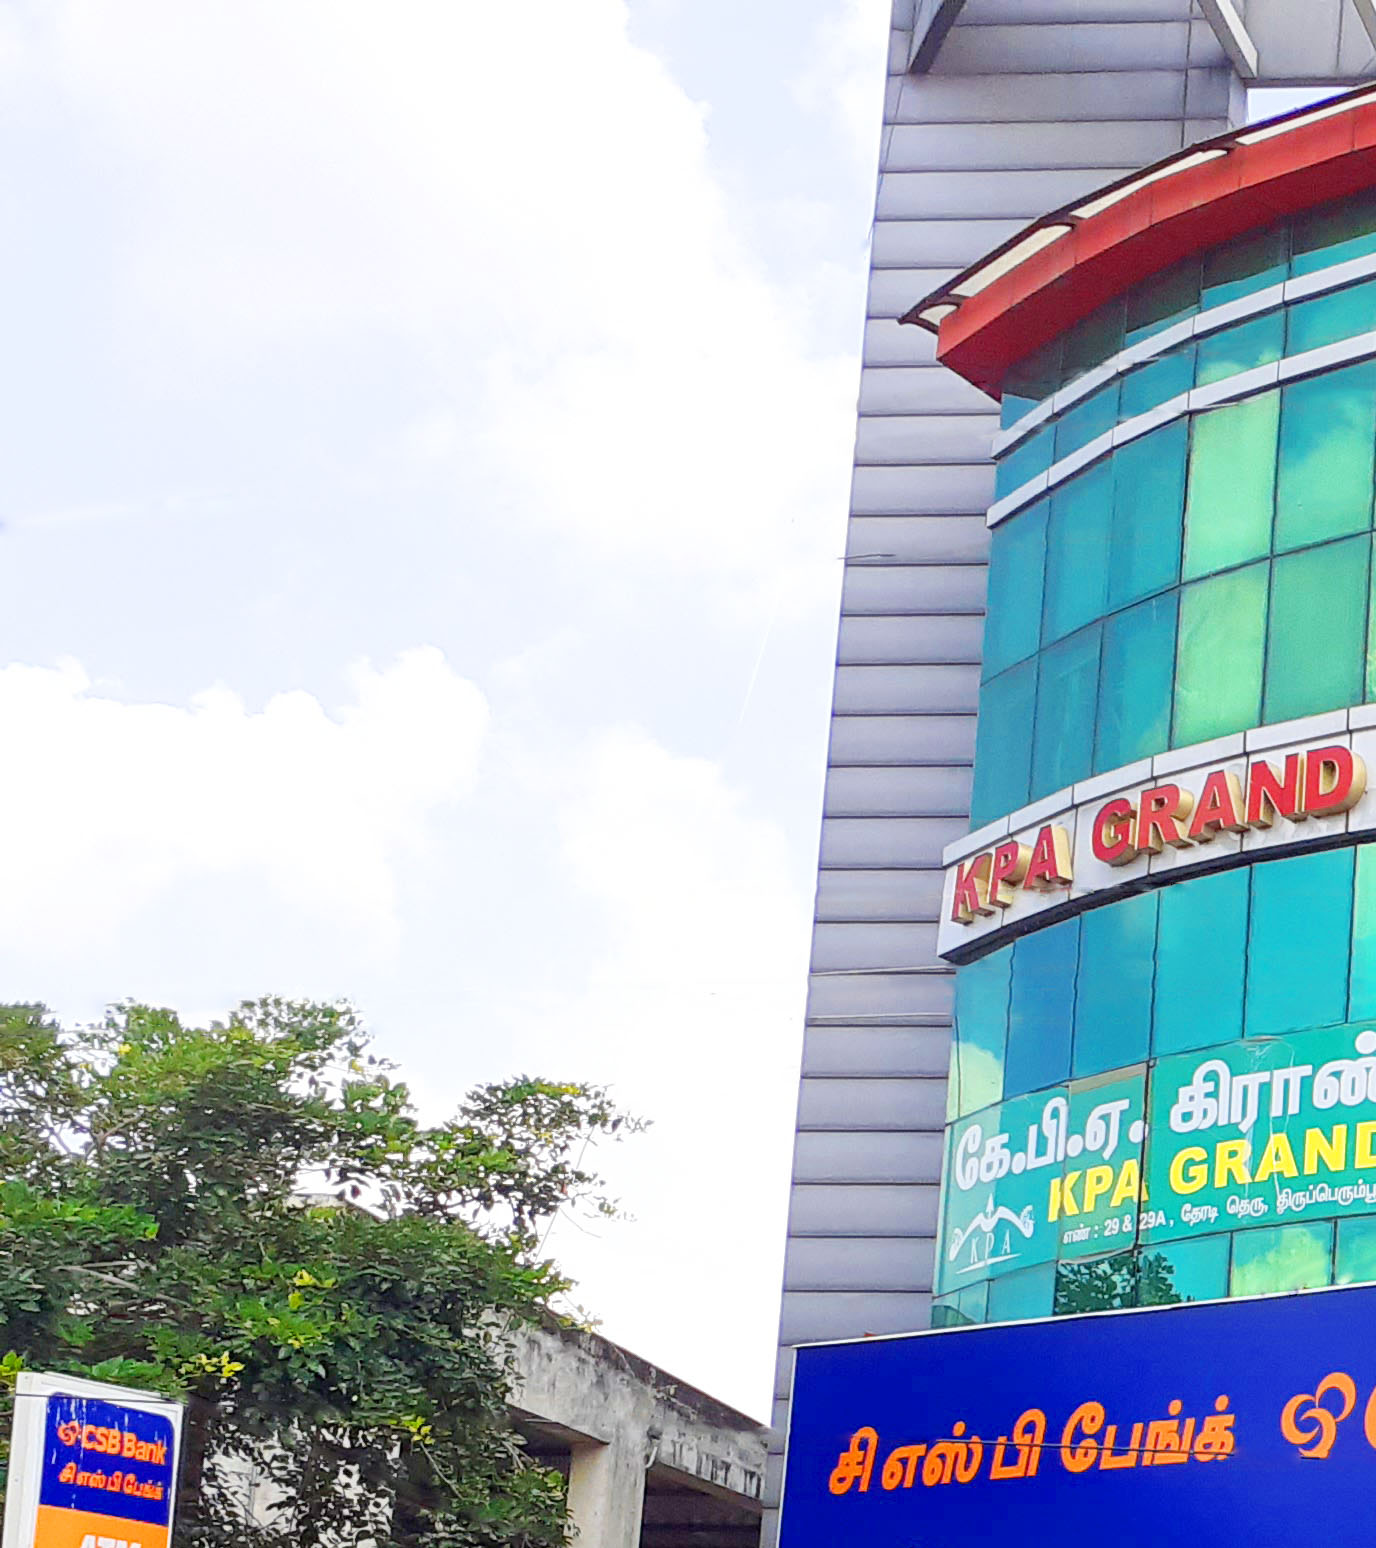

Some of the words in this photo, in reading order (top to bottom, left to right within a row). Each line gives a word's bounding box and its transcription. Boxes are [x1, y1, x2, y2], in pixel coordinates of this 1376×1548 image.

[950, 822, 1072, 925] KPA
[1091, 744, 1365, 868] GRAND
[1047, 1159, 1149, 1222] KPA
[1104, 1220, 1121, 1237] 29
[1122, 1215, 1133, 1232] &
[81, 1424, 123, 1456] CSB
[122, 1432, 168, 1466] Bank
